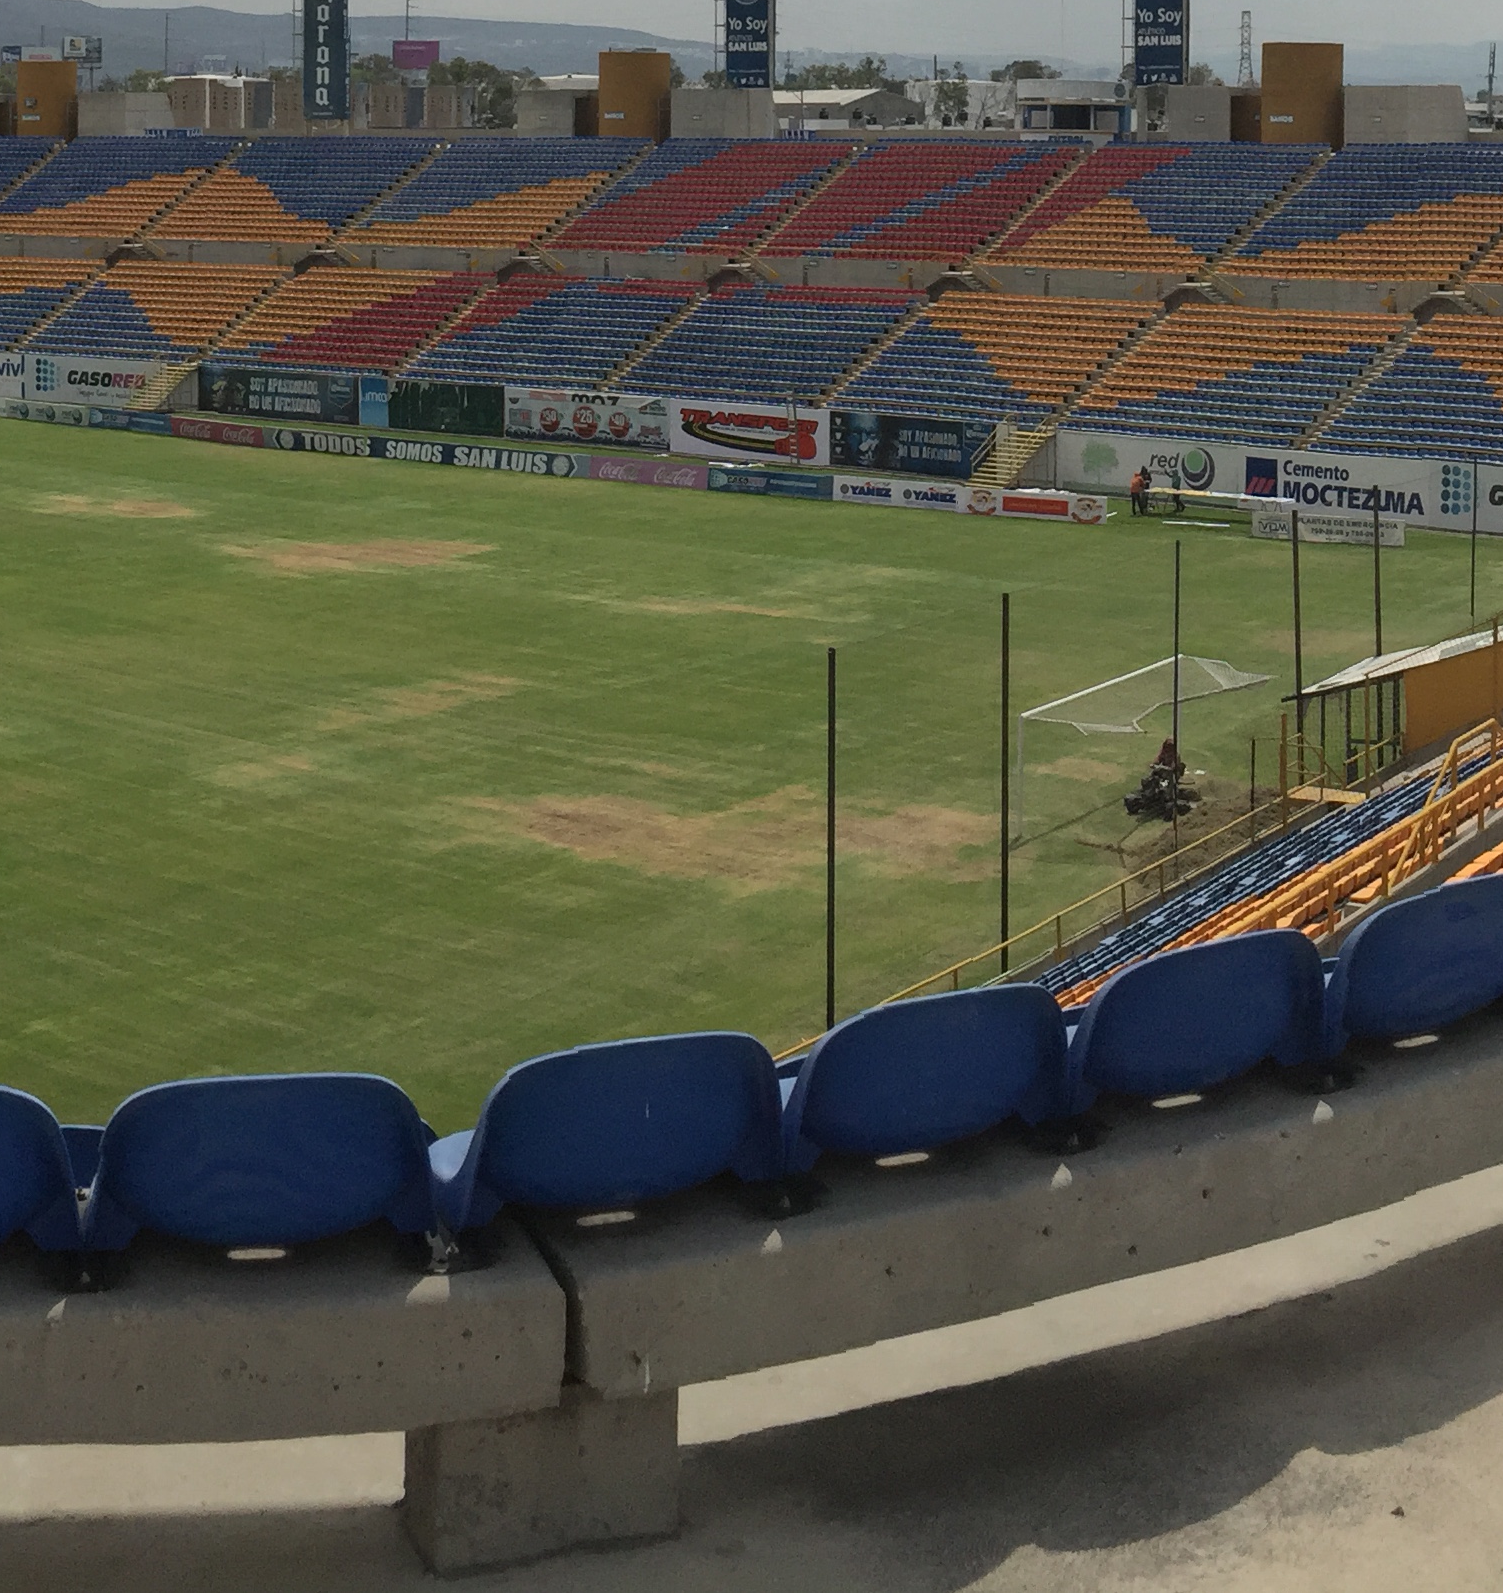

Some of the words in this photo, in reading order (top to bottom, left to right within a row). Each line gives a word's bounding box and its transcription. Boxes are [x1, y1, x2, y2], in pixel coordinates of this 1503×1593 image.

[728, 17, 742, 31] Yo
[746, 17, 767, 35] Soy
[1137, 9, 1153, 23] Yo
[1157, 8, 1182, 26] Soy
[728, 42, 747, 52] SAN
[749, 42, 767, 52] LUIS
[1138, 36, 1158, 46] SAN
[1160, 35, 1182, 46] LUIS
[301, 433, 371, 457] TODOS
[385, 440, 443, 463] SOMOS
[453, 446, 496, 469] SAN
[500, 450, 548, 474] LUIS
[1149, 452, 1180, 469] red
[1283, 459, 1350, 482] Cemento
[1283, 480, 1425, 516] MOCTEZUMA
